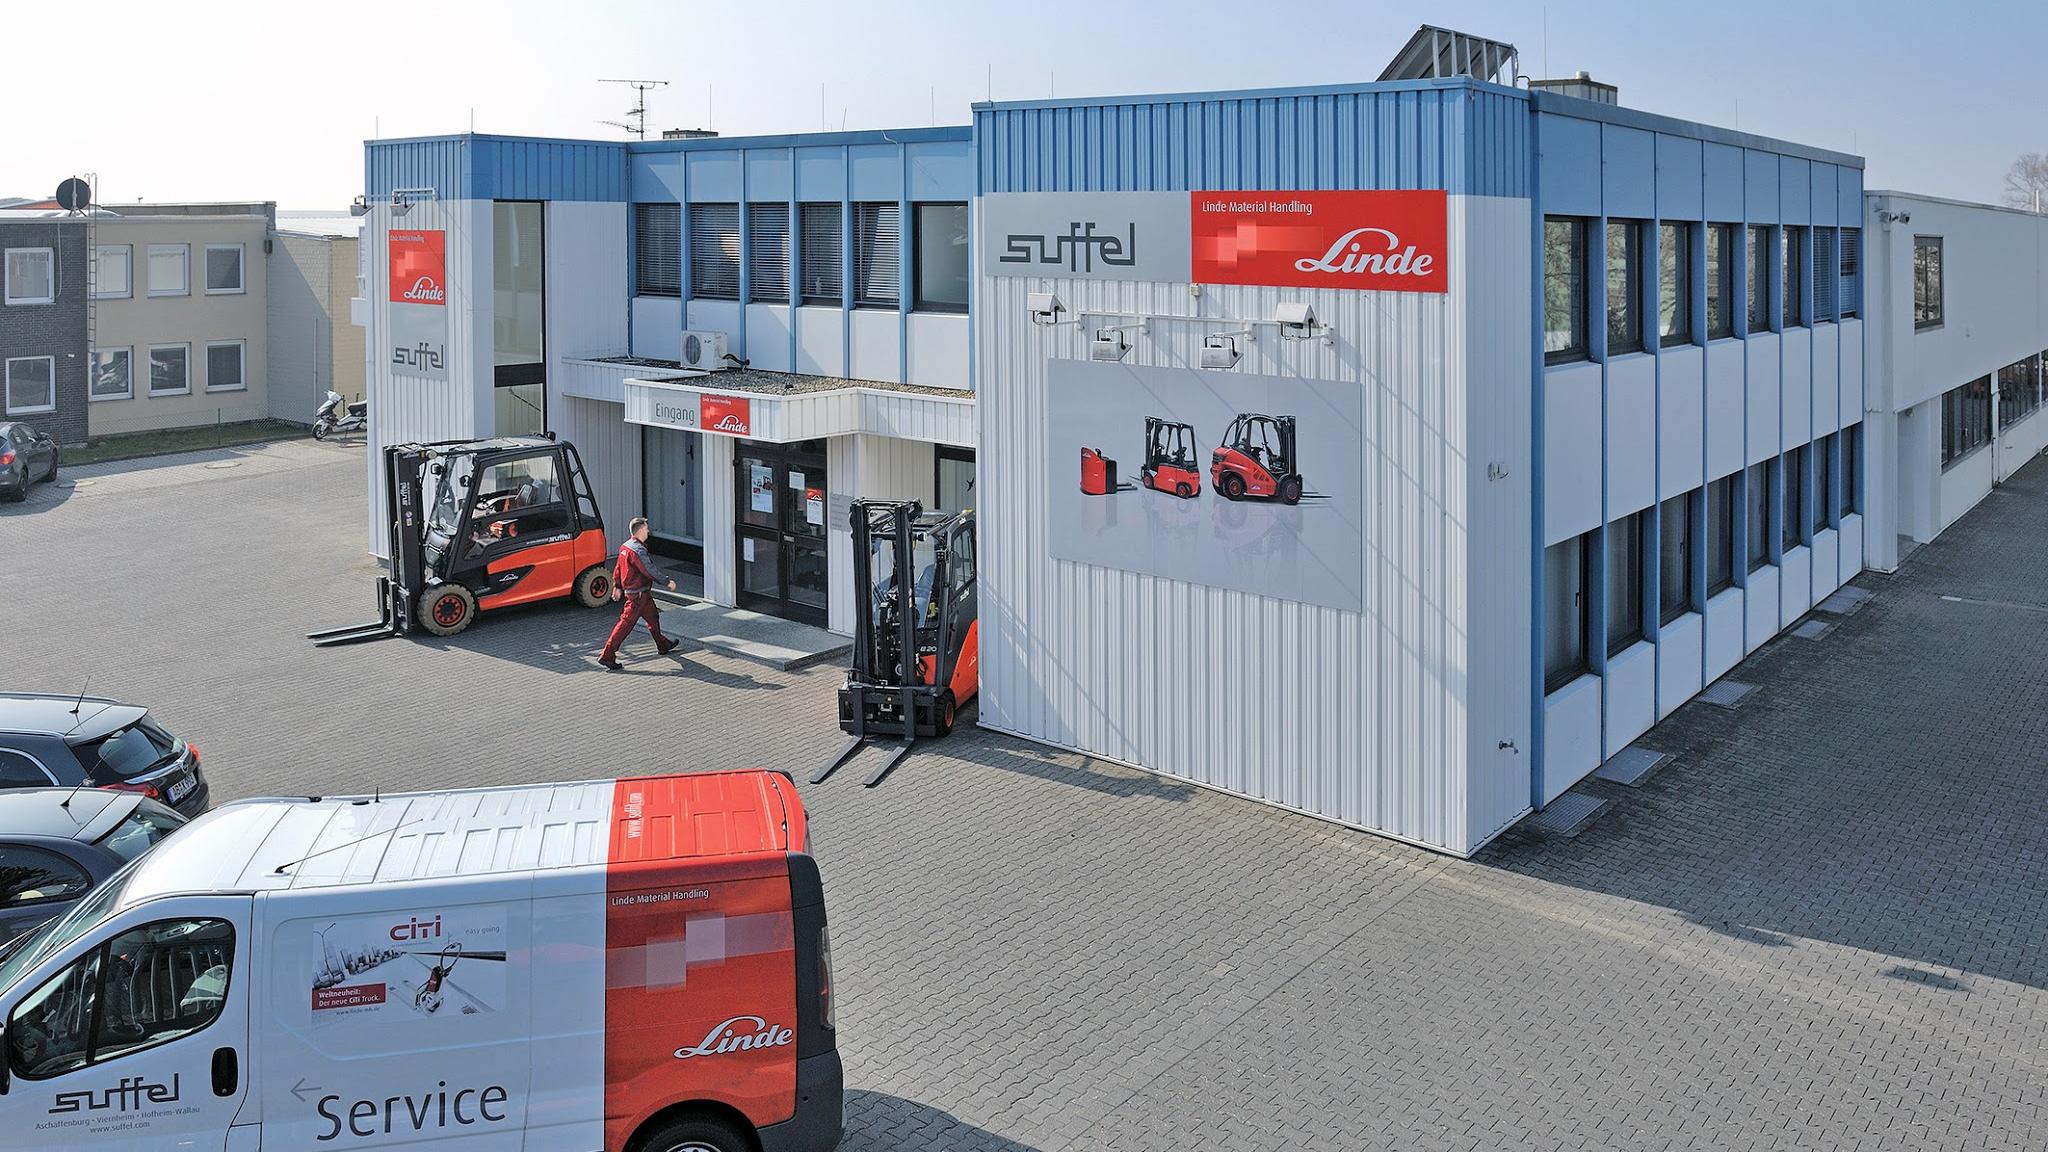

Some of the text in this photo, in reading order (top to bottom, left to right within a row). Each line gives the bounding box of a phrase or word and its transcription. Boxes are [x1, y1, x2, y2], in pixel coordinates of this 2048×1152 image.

[1202, 200, 1313, 215] Linde Material Handling
[1000, 222, 1135, 272] suffel
[1294, 227, 1433, 276] Linde
[404, 276, 444, 300] Linde
[393, 342, 444, 371] suffel
[655, 402, 695, 425] Eingang
[713, 414, 748, 433] Linde
[612, 888, 709, 906] Linde Material Handling
[465, 925, 500, 935] easy going
[318, 989, 361, 998] Weltneuheit:
[673, 1016, 793, 1059] Linde
[48, 1073, 179, 1113] suffel
[35, 1106, 200, 1130] Aschaffenburg Viernheim Hofheim-Wallau
[316, 1080, 507, 1141] Service
[89, 1121, 150, 1134] www.suffel.com
